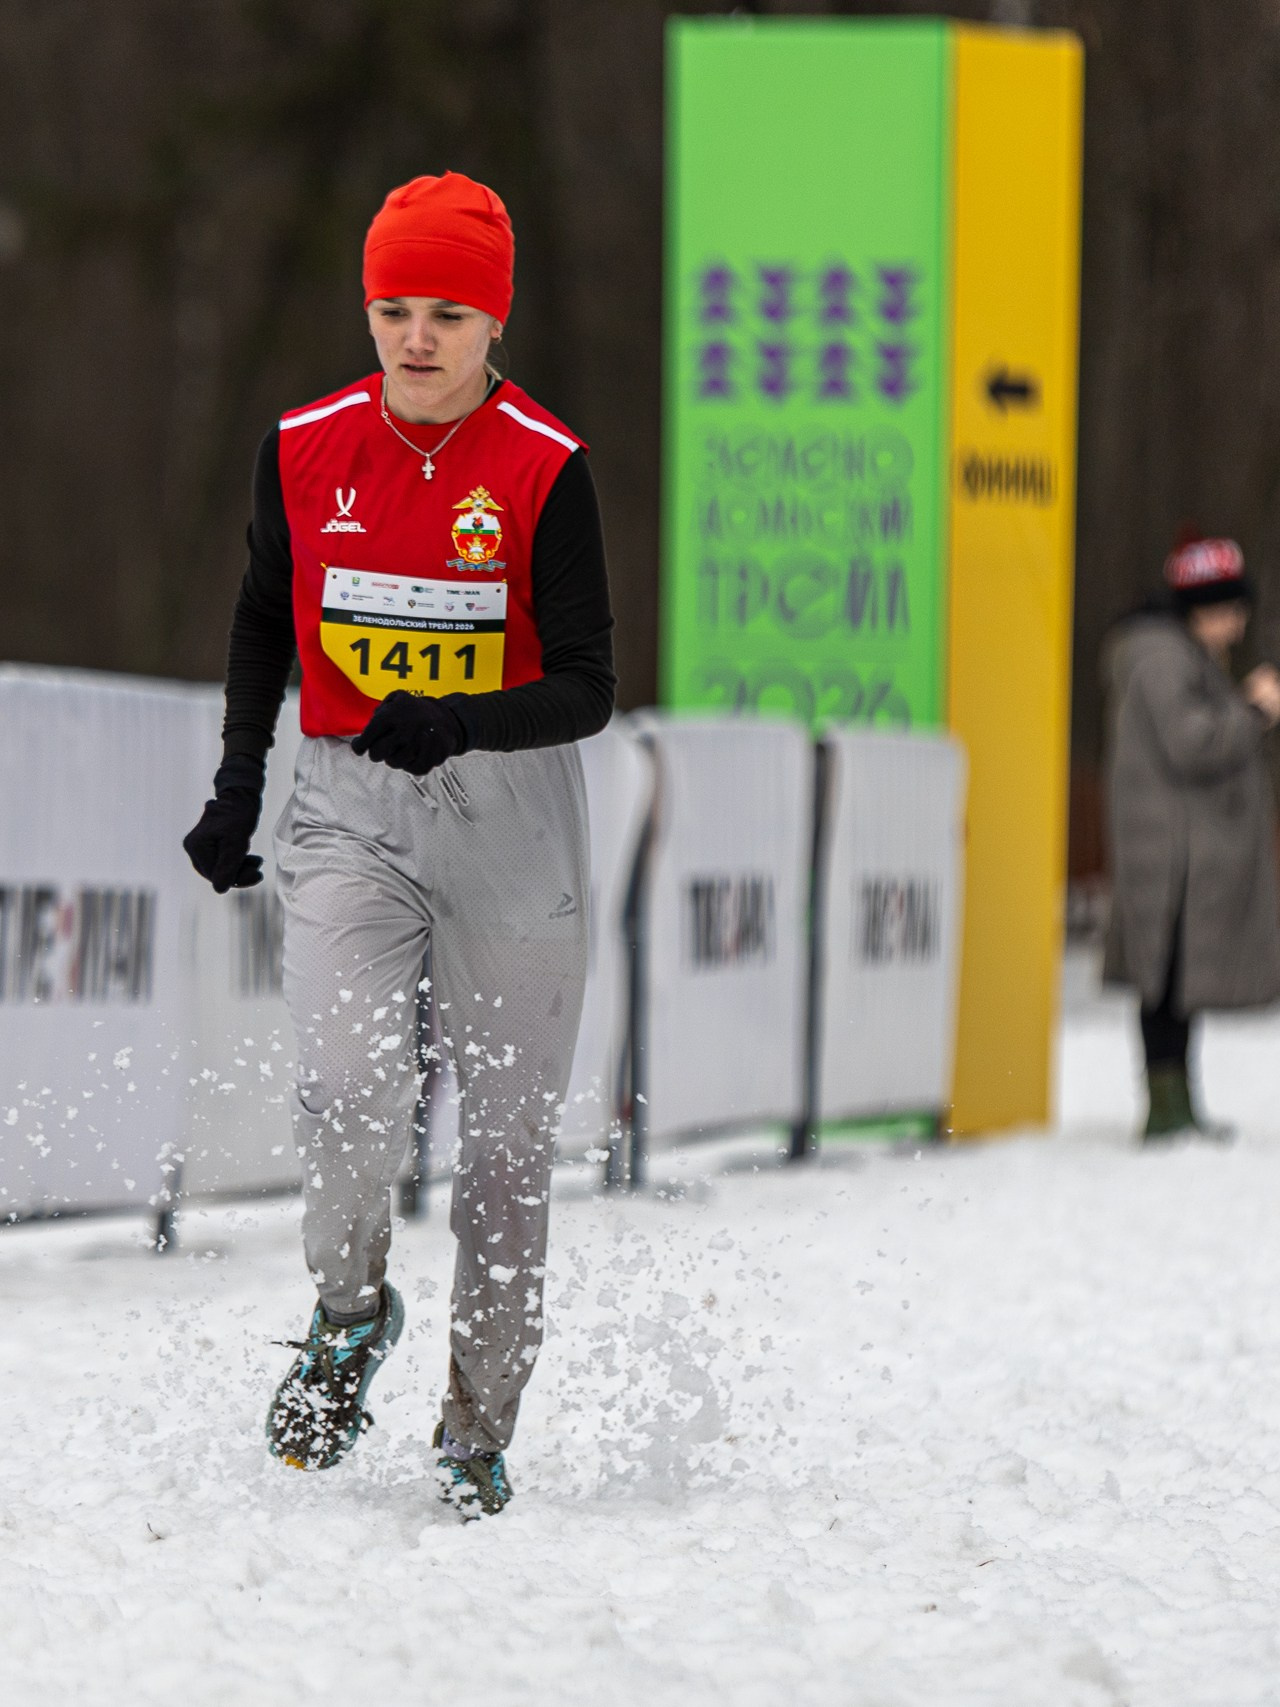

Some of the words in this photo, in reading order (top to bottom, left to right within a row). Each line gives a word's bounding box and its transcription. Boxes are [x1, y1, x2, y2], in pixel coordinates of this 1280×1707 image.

[320, 518, 367, 533] JÖGEL
[352, 613, 427, 629] ЗЕЛЕНОДОЛЬСКИЙ
[428, 620, 453, 631] ТРЕЙЛ
[349, 637, 476, 681] 1411
